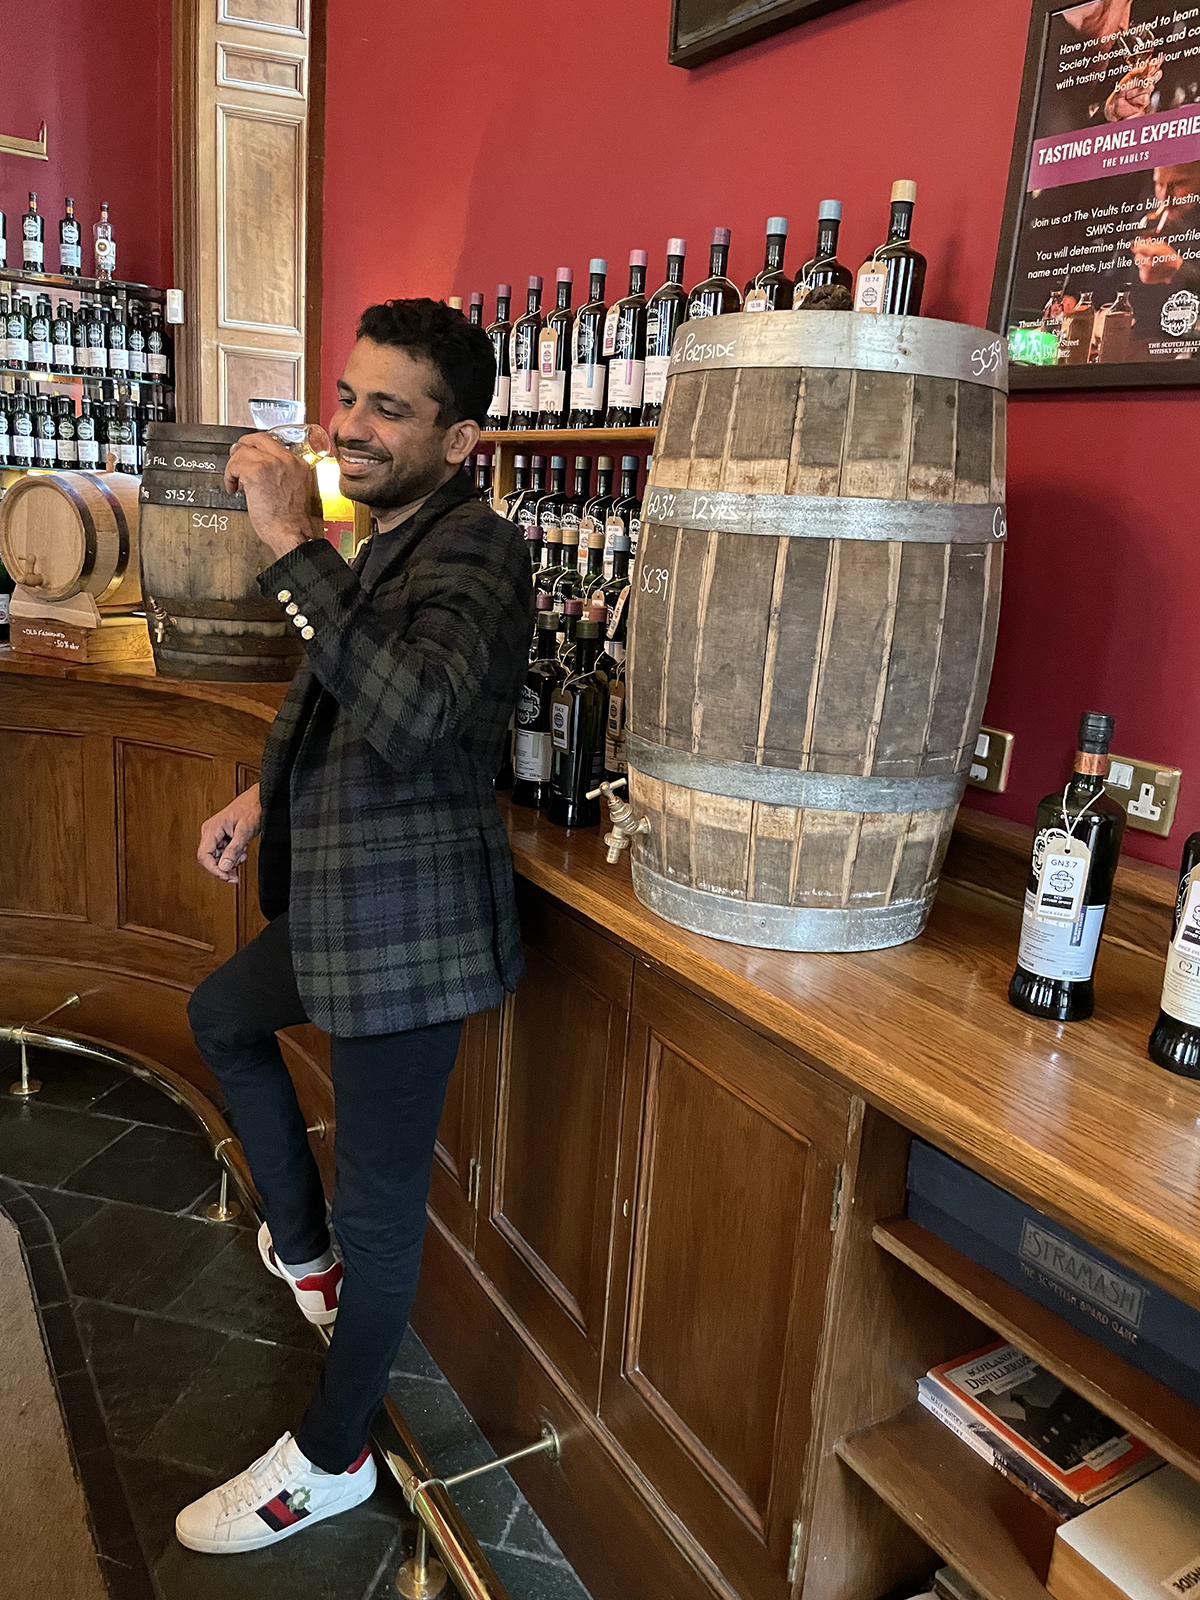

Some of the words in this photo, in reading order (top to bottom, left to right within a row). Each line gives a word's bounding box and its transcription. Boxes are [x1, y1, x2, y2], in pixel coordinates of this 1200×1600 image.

[1060, 43, 1081, 55] Have
[1082, 37, 1098, 53] you
[1101, 31, 1120, 43] ever
[1123, 20, 1157, 37] wanted
[1160, 15, 1170, 26] to
[1173, 8, 1198, 22] learn
[1058, 55, 1091, 72] Society
[1093, 47, 1129, 63] chooses
[1133, 37, 1164, 53] names
[1166, 29, 1186, 43] and
[1056, 75, 1074, 90] with
[1076, 69, 1105, 85] tasting
[1108, 63, 1133, 77] notes
[1135, 57, 1148, 70] for
[1150, 53, 1164, 66] all
[1165, 50, 1181, 62] our
[1184, 46, 1200, 58] wo
[1115, 70, 1161, 93] bottlings?
[1038, 139, 1091, 166] TASTING
[1094, 130, 1137, 154] PANEL
[1102, 158, 1116, 168] THE
[1120, 151, 1149, 165] VAULTS
[1032, 217, 1050, 229] Join
[1052, 216, 1060, 225] us
[1062, 213, 1071, 223] at
[1074, 210, 1088, 221] The
[1091, 204, 1118, 218] Vaults
[1121, 202, 1134, 213] for
[1146, 196, 1169, 210] blind
[1172, 194, 1200, 206] tastin
[1035, 251, 1051, 261] You
[1054, 246, 1067, 258] will
[1070, 242, 1114, 256] determine
[1117, 238, 1131, 250] the
[1133, 233, 1166, 247] flavour
[1168, 229, 1200, 244] profile
[1085, 223, 1114, 238] SMWS
[1027, 268, 1050, 280] name
[1052, 264, 1069, 276] and
[1071, 260, 1096, 273] notes,
[1098, 259, 1114, 273] just
[1117, 256, 1132, 268] like
[1135, 256, 1150, 265] our
[1152, 251, 1180, 266] panel
[682, 333, 736, 363] PORTSIDE
[971, 340, 1002, 376] SC39
[192, 513, 228, 534] SC48
[641, 564, 669, 601] SC39
[1050, 858, 1078, 869] GN3.7
[1178, 944, 1190, 952] PRICE
[1029, 1231, 1136, 1312] STRAMASH
[1038, 1274, 1076, 1306] SCOTTISH
[1080, 1300, 1109, 1327] BOARD
[1111, 1320, 1138, 1345] GAME
[930, 1395, 943, 1410] MALT
[944, 1408, 963, 1426] WHISKY
[931, 1406, 944, 1421] MALT
[944, 1420, 963, 1436] WHISKY
